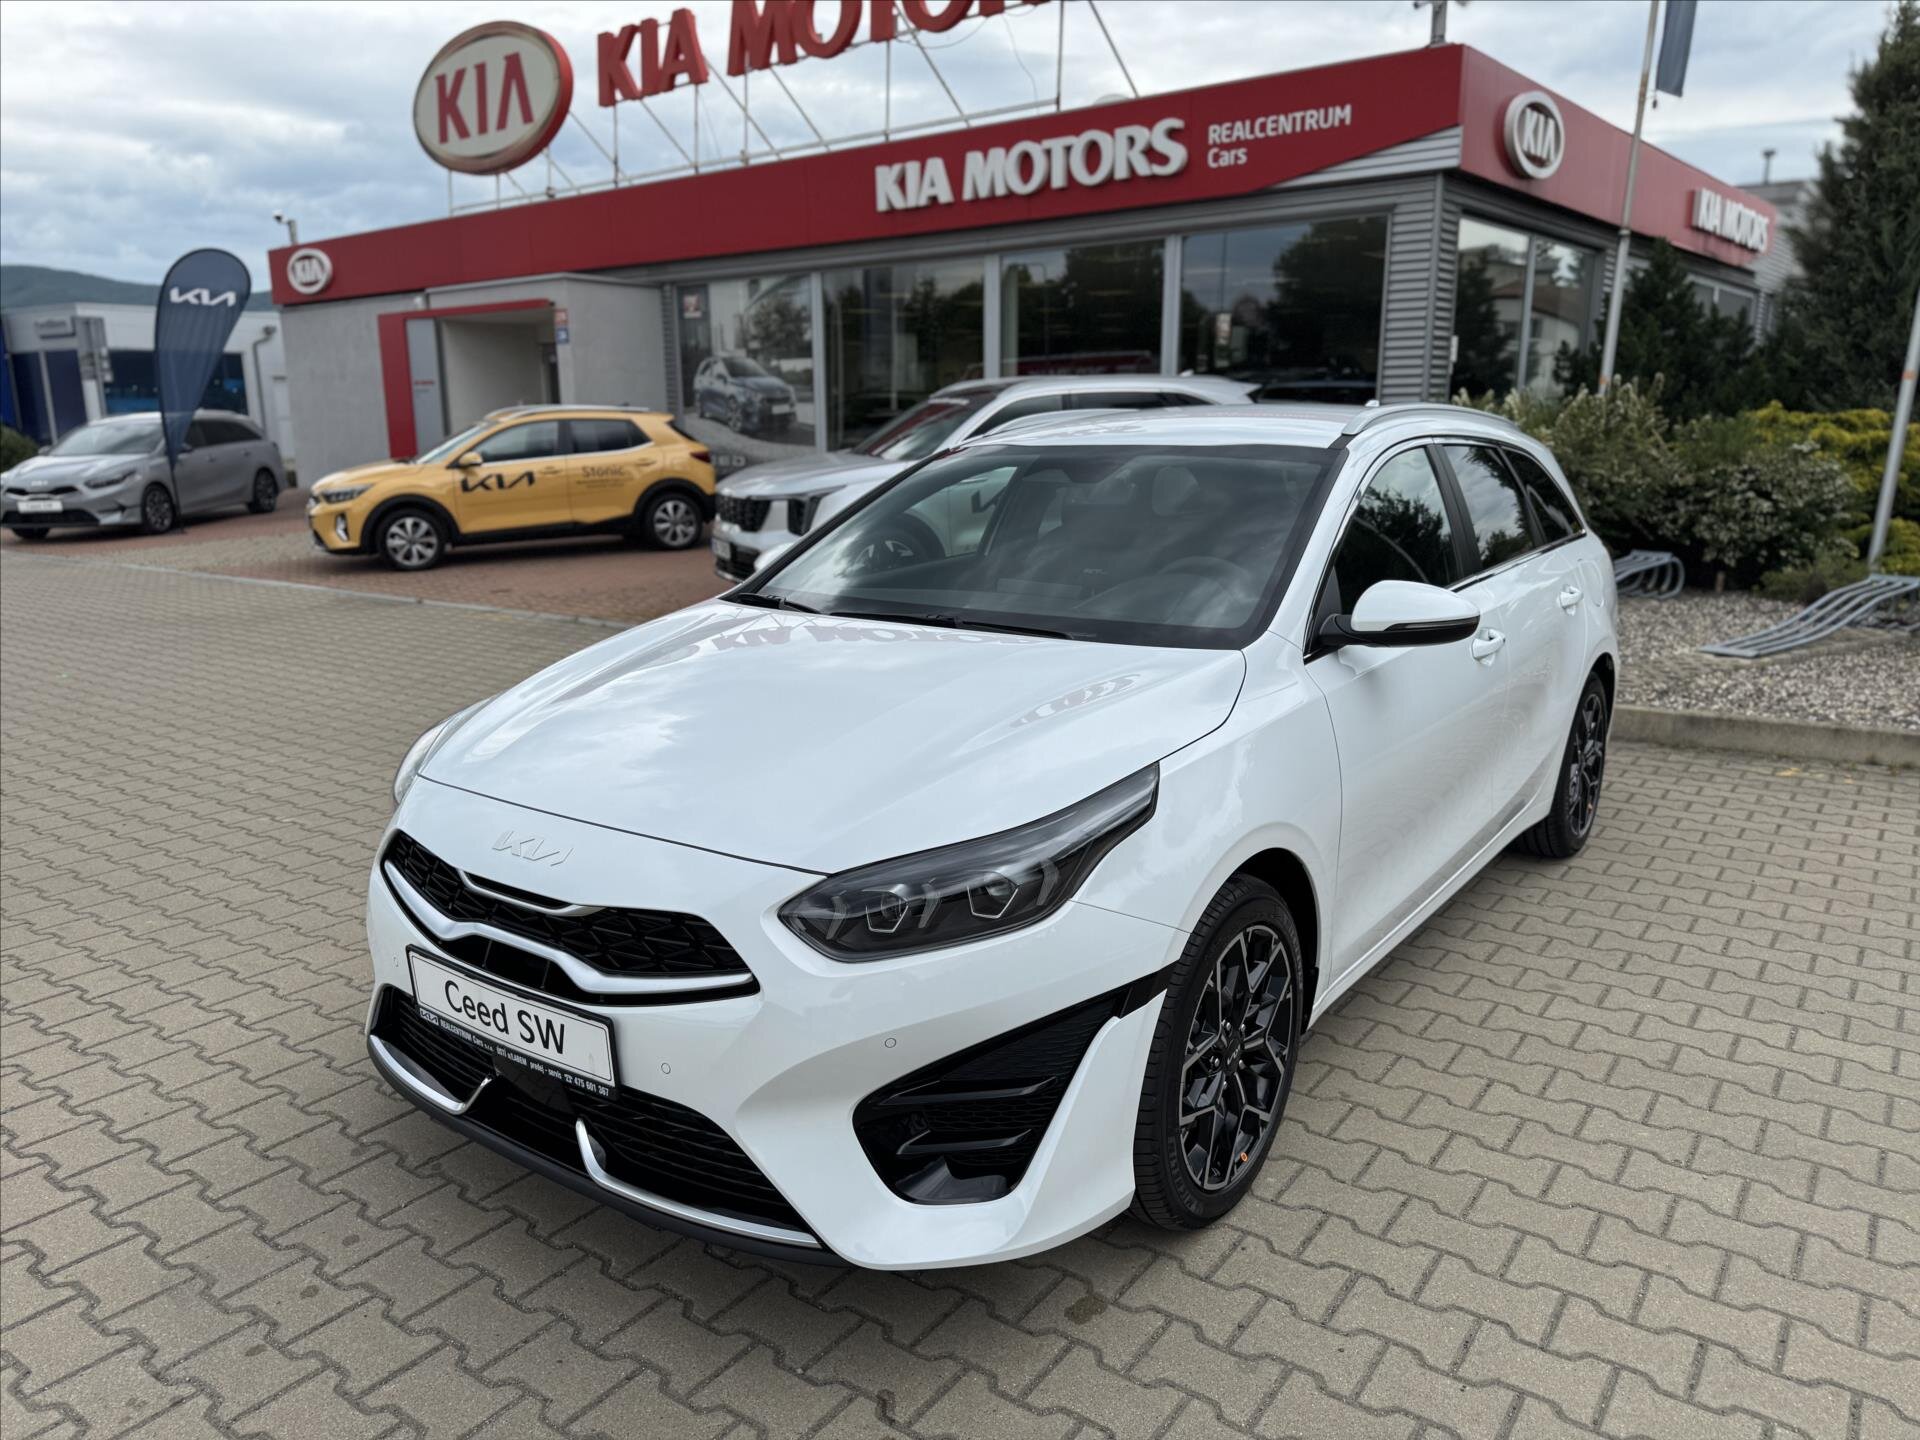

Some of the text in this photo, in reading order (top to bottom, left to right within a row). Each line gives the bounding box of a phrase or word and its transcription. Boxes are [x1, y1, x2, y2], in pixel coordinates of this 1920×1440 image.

[598, 8, 707, 106] KIA
[435, 52, 534, 144] KIA
[1207, 104, 1352, 145] REALCENTRUM
[1207, 147, 1247, 168] Cars
[1522, 107, 1555, 161] KIA
[875, 118, 1188, 212] KIA MOTORS
[1698, 187, 1770, 250] KIA MOTORS
[169, 286, 236, 307] KIA
[295, 257, 324, 285] KIA
[461, 471, 535, 493] KIA
[491, 830, 574, 867] KIA
[445, 980, 565, 1054] Ceed SW
[421, 1009, 439, 1025] KIA
[440, 1019, 472, 1041] REALCENTRUM
[472, 1035, 484, 1047] Cars
[575, 1075, 585, 1088] 475
[586, 1080, 597, 1092] 601
